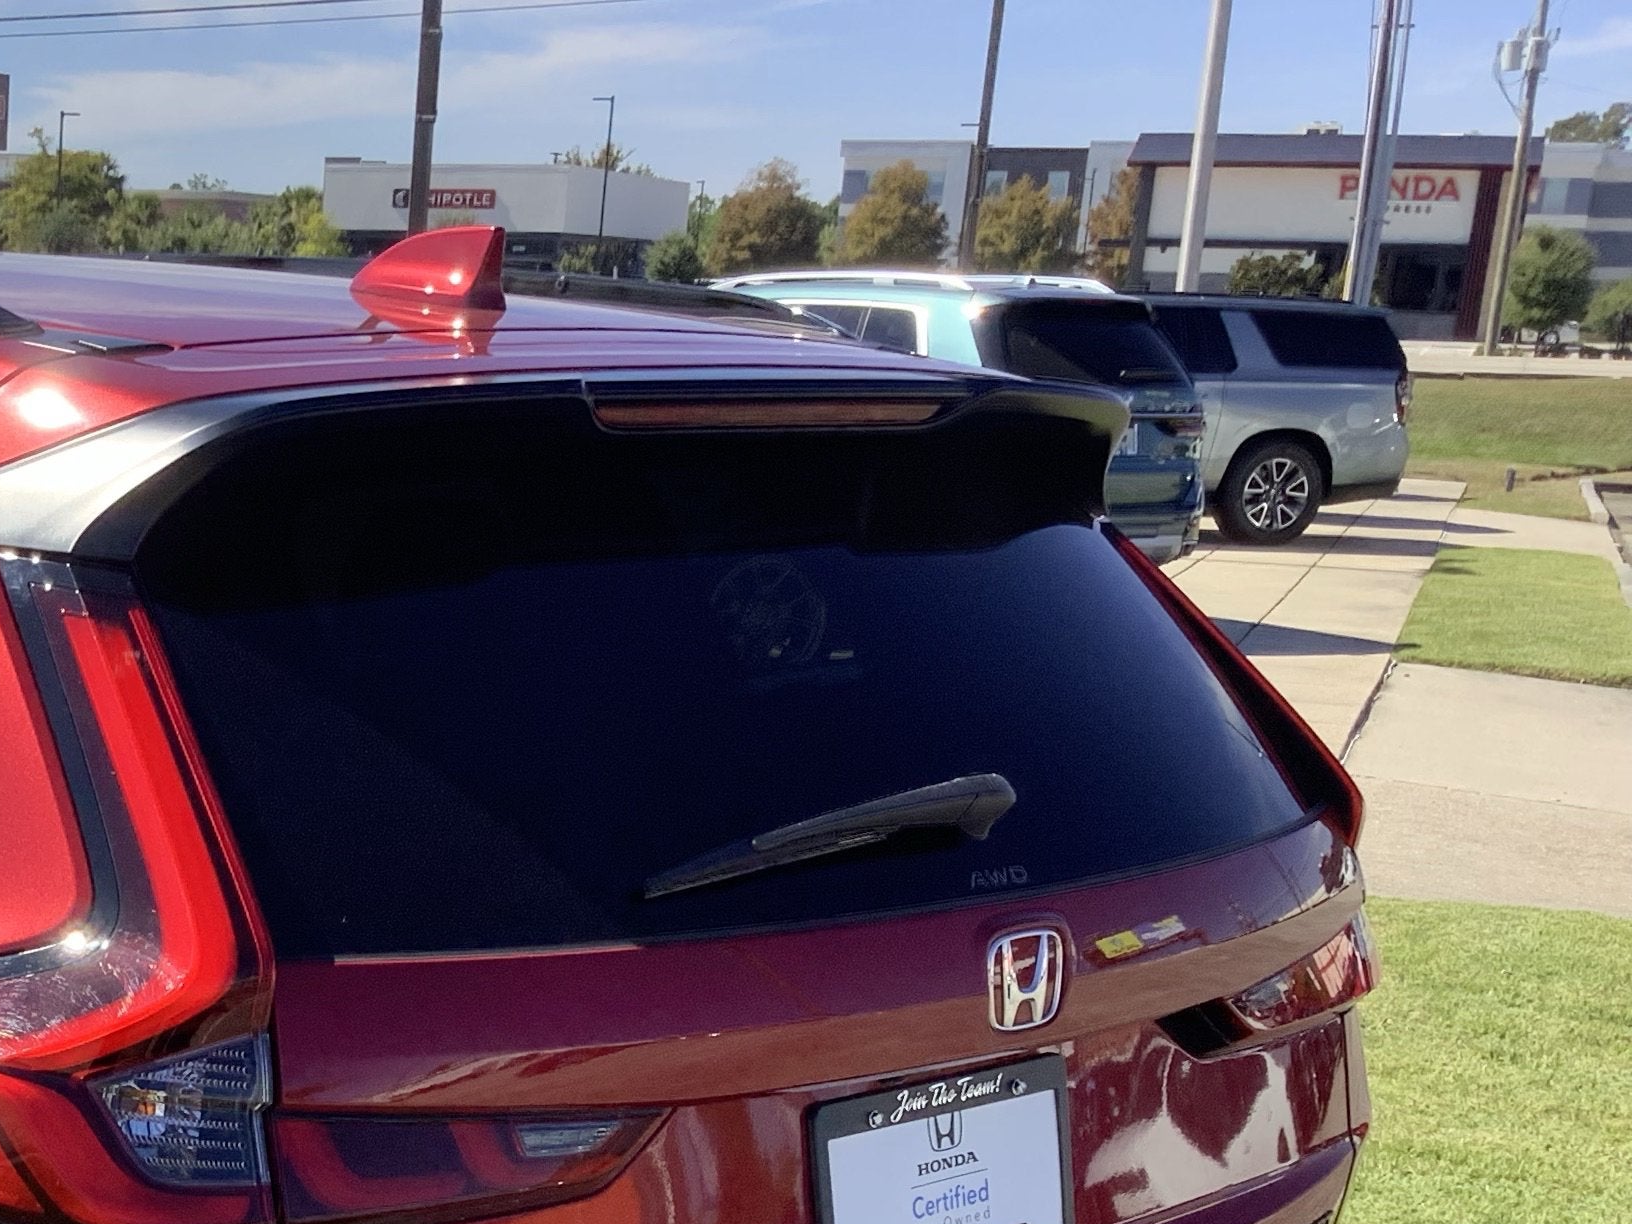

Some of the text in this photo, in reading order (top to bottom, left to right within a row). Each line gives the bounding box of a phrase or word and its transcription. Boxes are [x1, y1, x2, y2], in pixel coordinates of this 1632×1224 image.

[426, 192, 492, 206] HIPOTLE
[1339, 174, 1460, 201] PNDA
[970, 865, 1028, 889] AWD
[889, 1072, 1004, 1123] Join The Team!
[916, 1151, 979, 1176] HONDA
[912, 1178, 990, 1219] Certified
